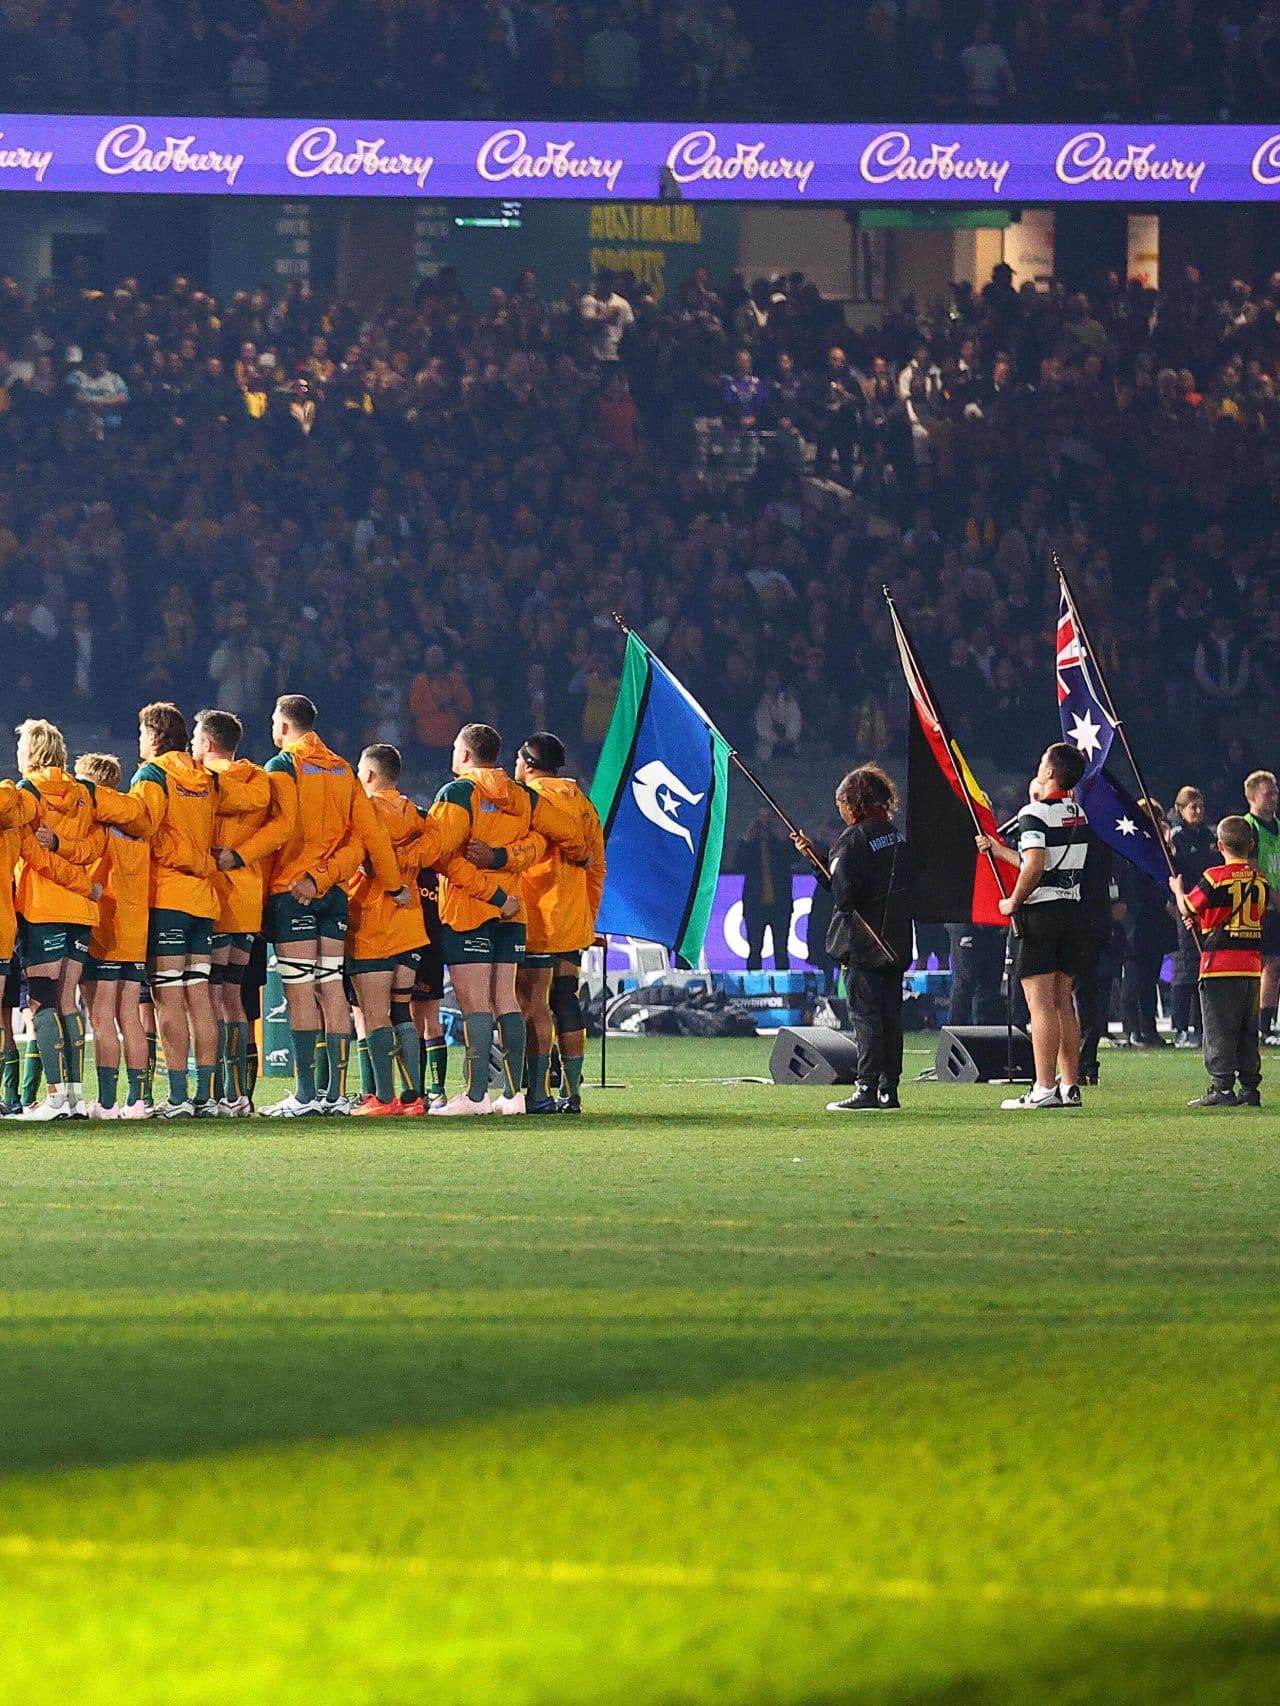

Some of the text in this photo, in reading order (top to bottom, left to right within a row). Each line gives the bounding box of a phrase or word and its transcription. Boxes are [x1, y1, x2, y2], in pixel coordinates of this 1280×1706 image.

[95, 124, 244, 185] Cadbury
[286, 127, 434, 188] Cadbury
[476, 129, 623, 190] Cadbury
[666, 131, 814, 192] Cadbury
[860, 131, 1010, 192] Cadbury
[1055, 132, 1205, 193] Cadbury
[1228, 880, 1266, 928] 10
